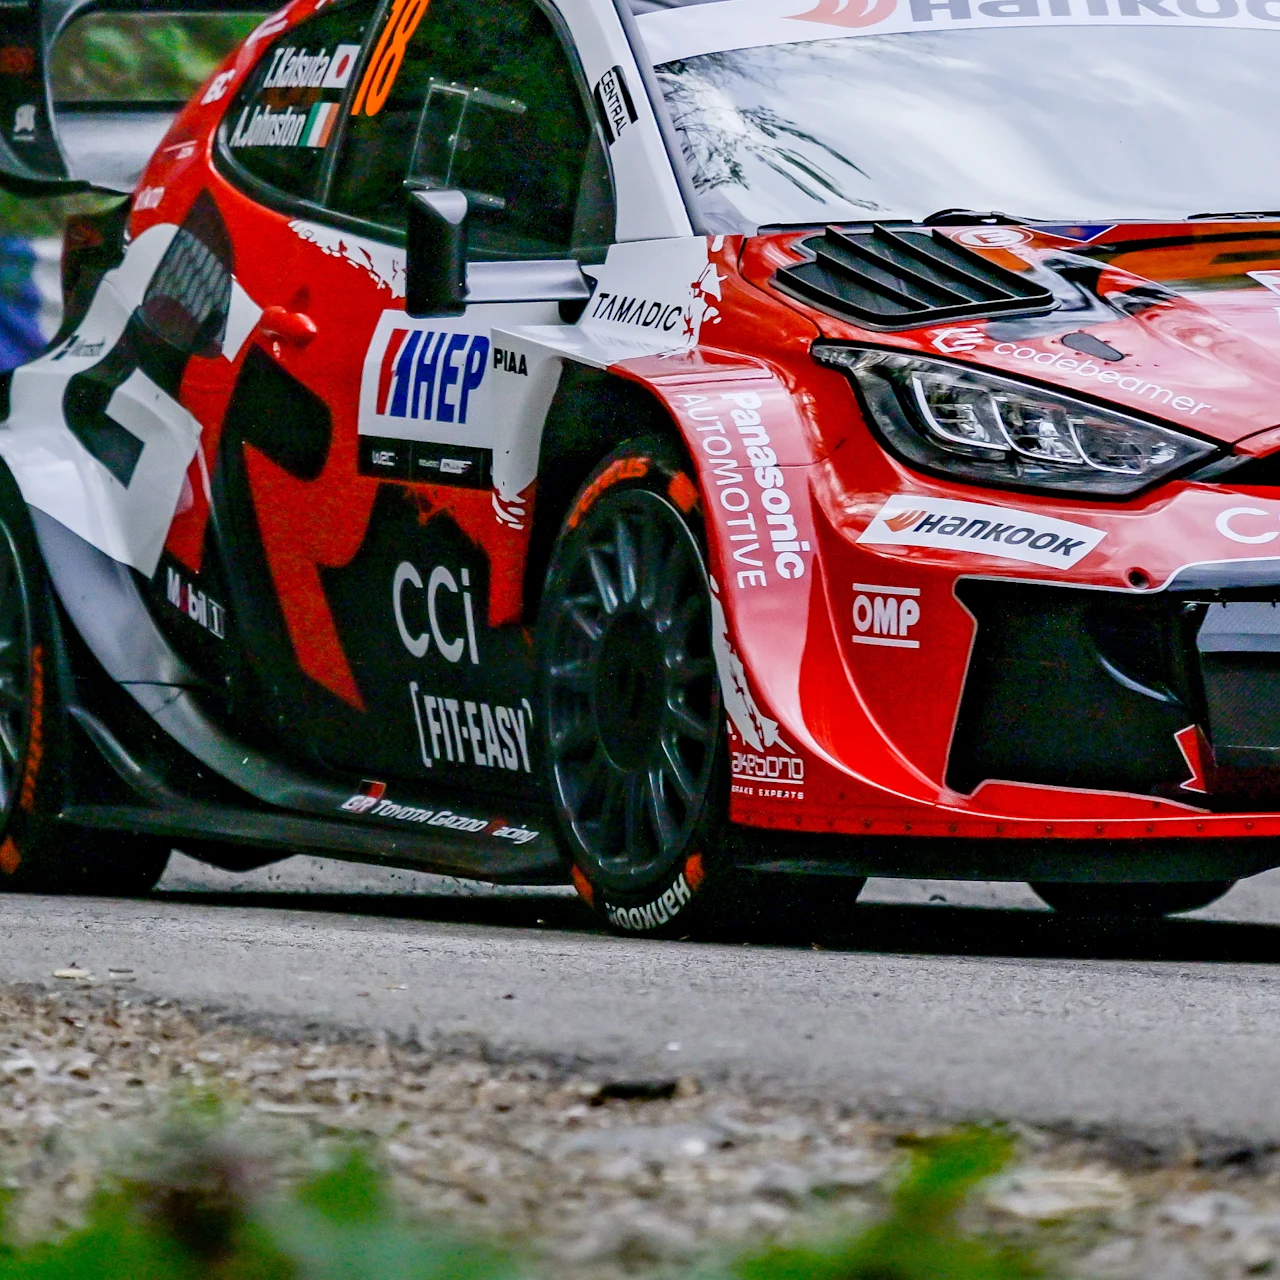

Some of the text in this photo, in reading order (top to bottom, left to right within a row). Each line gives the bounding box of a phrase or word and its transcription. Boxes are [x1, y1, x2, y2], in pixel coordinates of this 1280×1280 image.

[600, 70, 627, 137] CENTRAL
[229, 104, 307, 148] A.Johnston
[592, 292, 684, 332] TAMADIC
[493, 347, 529, 377] PIAA
[992, 341, 1213, 416] codebeamer
[678, 393, 767, 589] AUTOMOTIVE
[721, 391, 810, 581] Panasonic
[852, 595, 921, 637] OMP
[731, 785, 804, 800] BRAKE EXPERTS
[370, 799, 434, 824] TOYOTA
[427, 810, 489, 833] GAZOO
